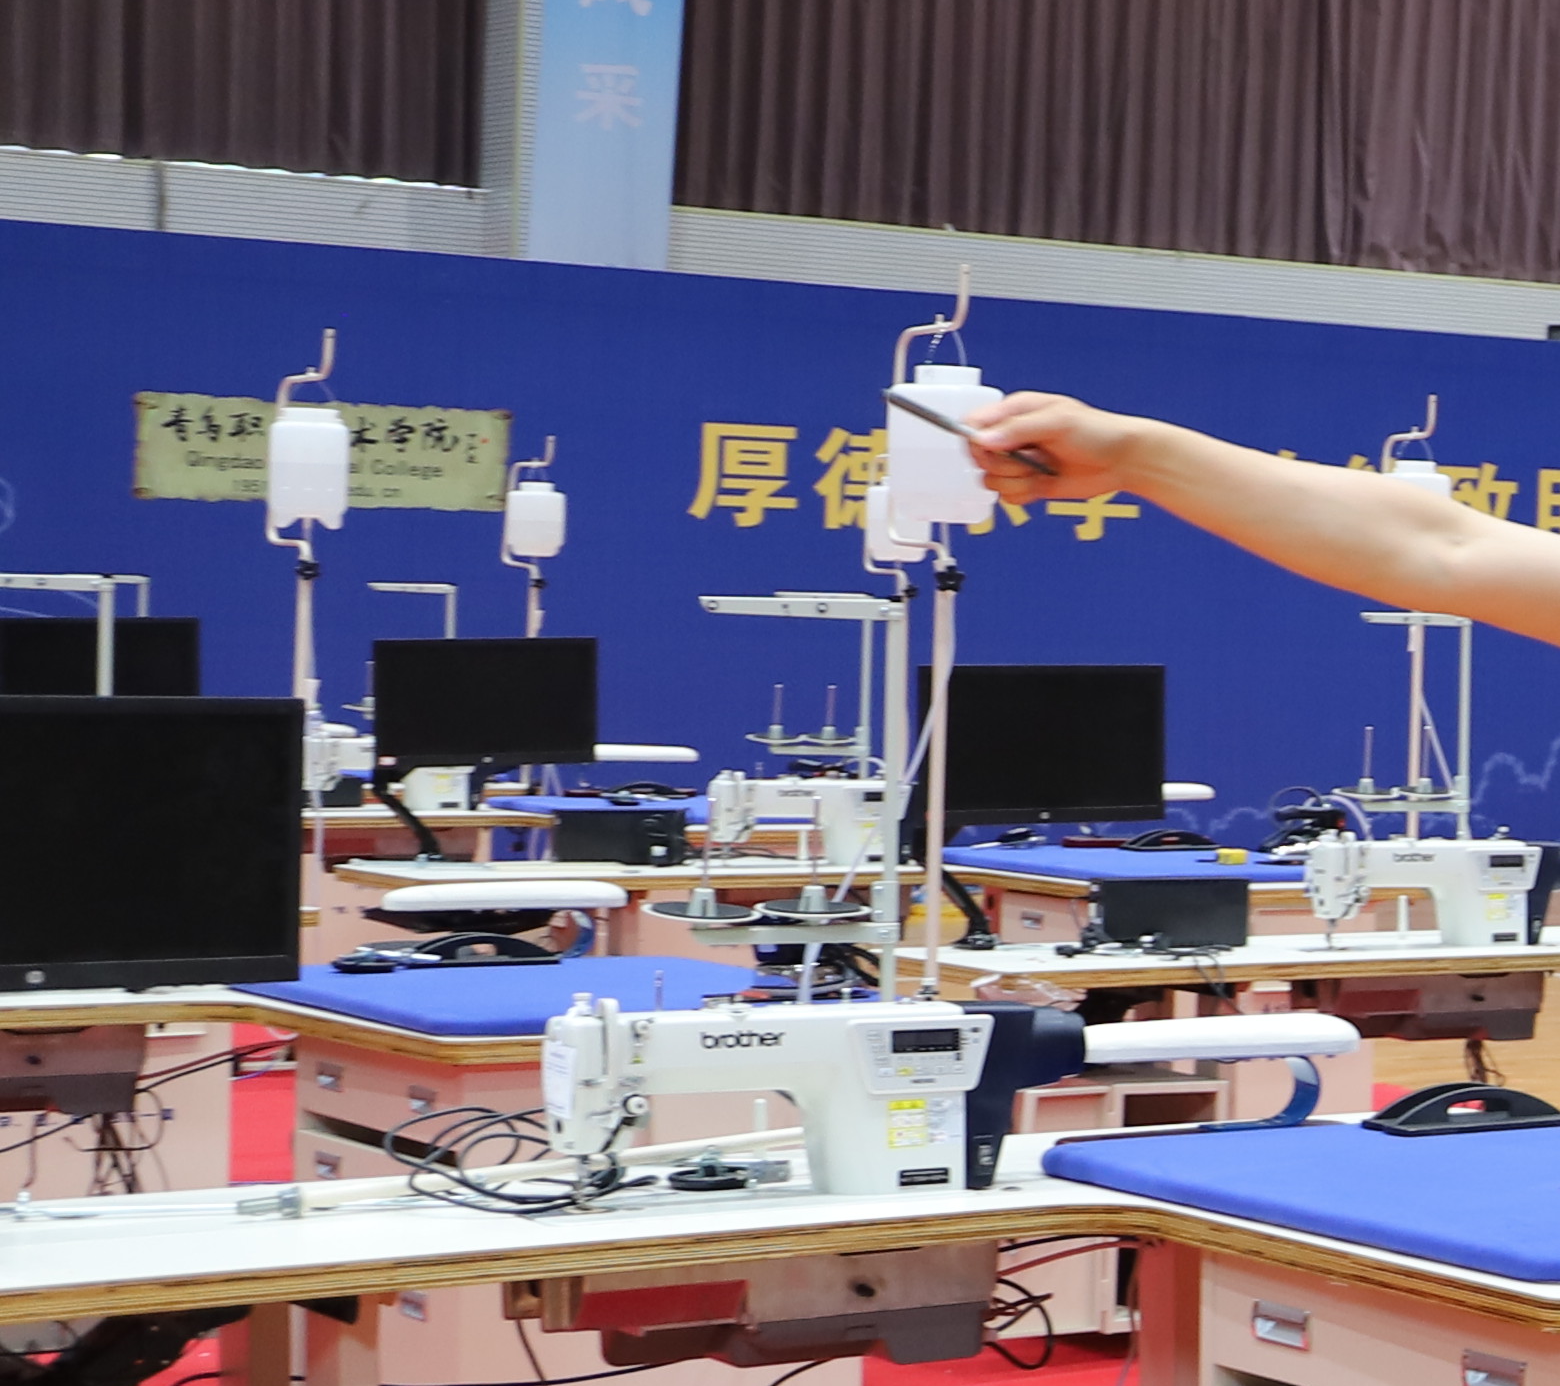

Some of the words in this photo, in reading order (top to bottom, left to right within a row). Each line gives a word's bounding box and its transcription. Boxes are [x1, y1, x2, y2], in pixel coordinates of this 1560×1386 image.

[161, 403, 461, 453] 青岛职术学院
[372, 457, 445, 479] College
[700, 1030, 786, 1049] brother
